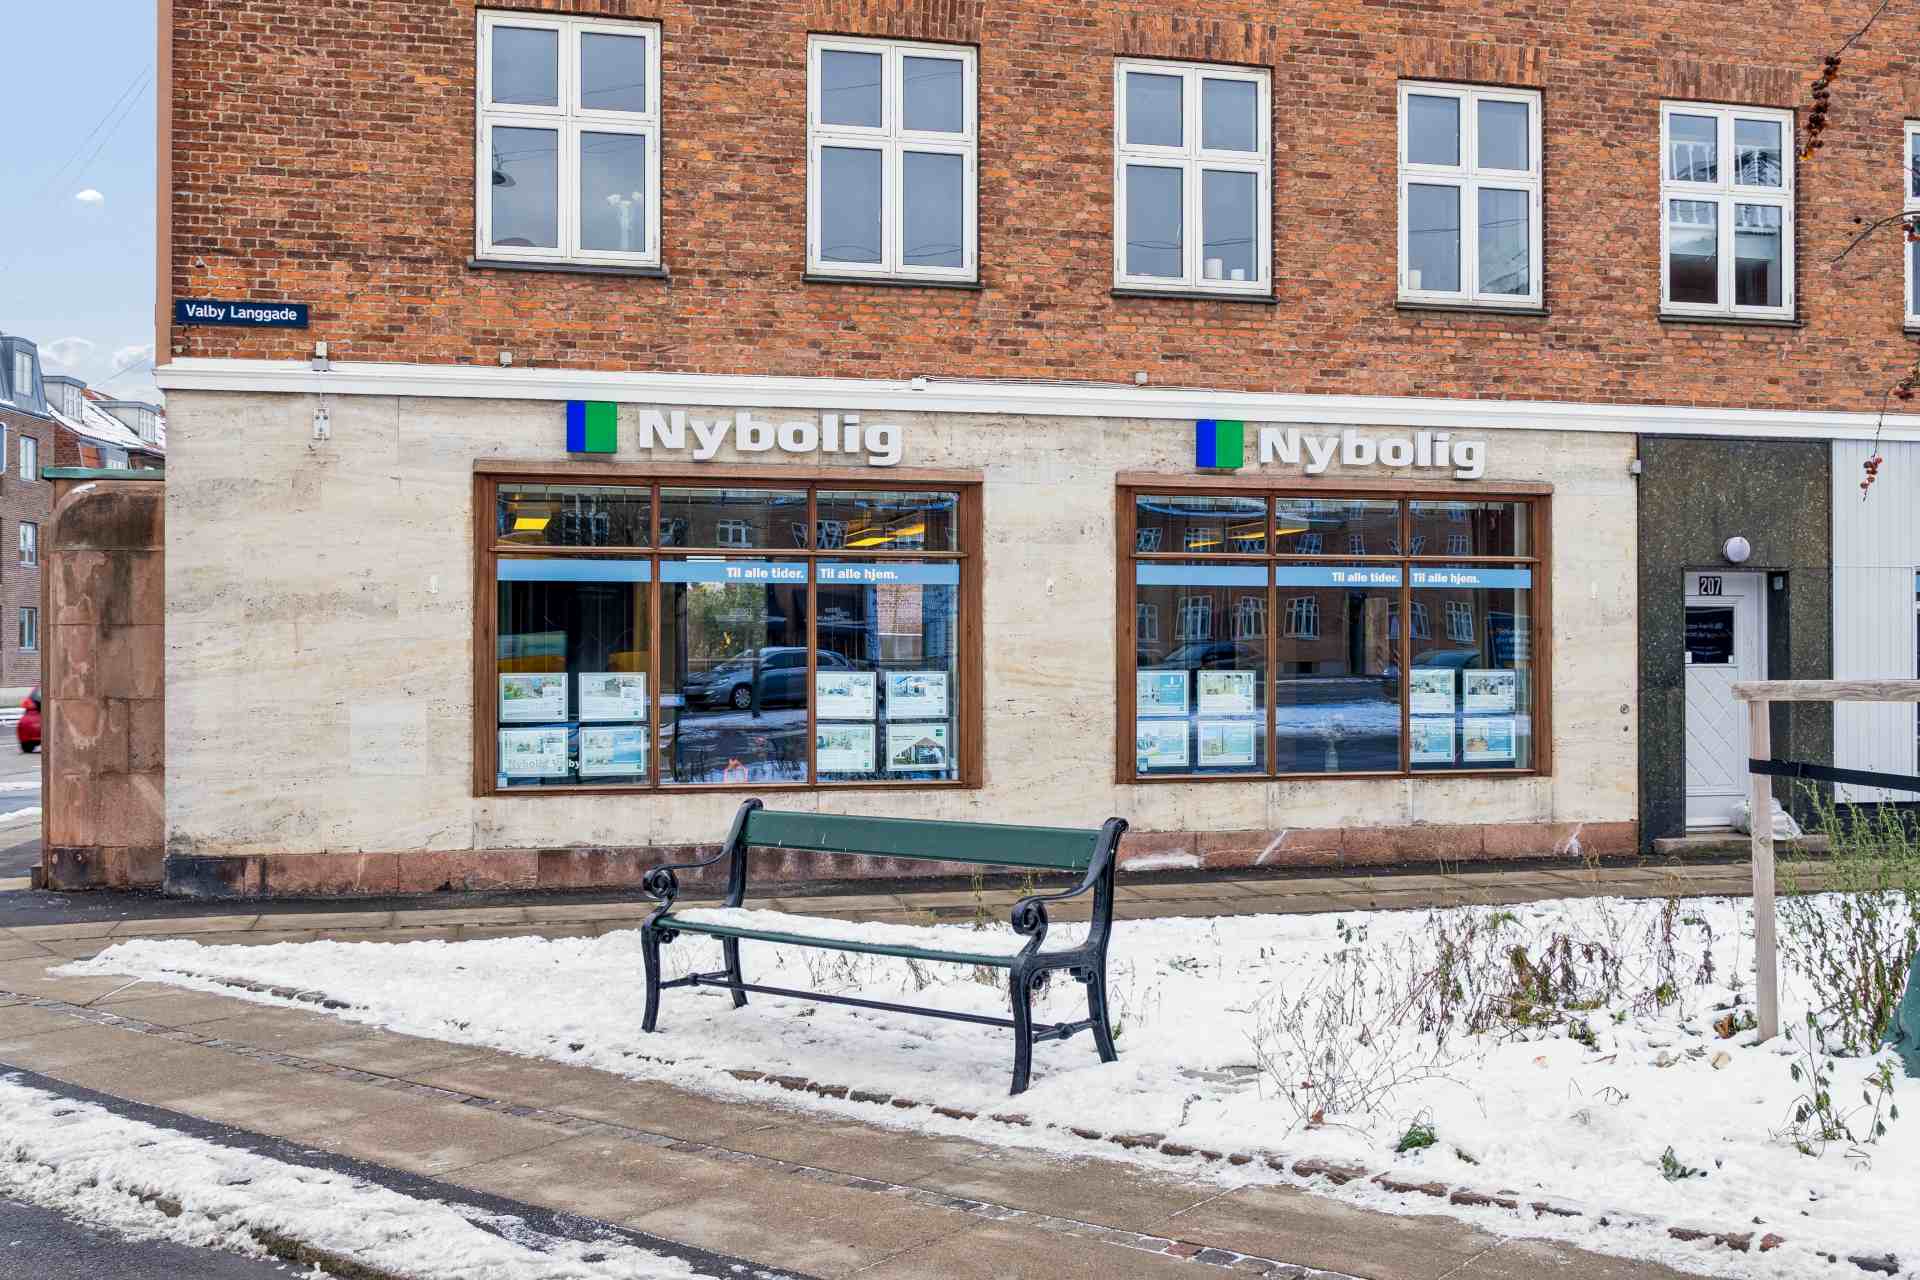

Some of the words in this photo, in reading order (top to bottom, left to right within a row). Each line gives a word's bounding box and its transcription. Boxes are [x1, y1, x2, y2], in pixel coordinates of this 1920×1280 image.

[185, 303, 226, 320] Valby
[230, 306, 298, 322] Langgade
[638, 408, 903, 467] Nybolig
[1258, 427, 1487, 480] Nybolig
[726, 567, 741, 578] Til
[744, 567, 769, 578] alle
[771, 567, 804, 579] tider.
[820, 568, 834, 579] Til
[837, 568, 862, 579] alle
[864, 568, 898, 582] hjem.
[1332, 571, 1345, 582] Til
[1347, 572, 1368, 583] alle
[1370, 572, 1399, 583] tider.
[1413, 572, 1426, 583] Til
[1428, 573, 1448, 584] alle
[1450, 573, 1480, 585] hjem.
[1700, 577, 1721, 595] 207
